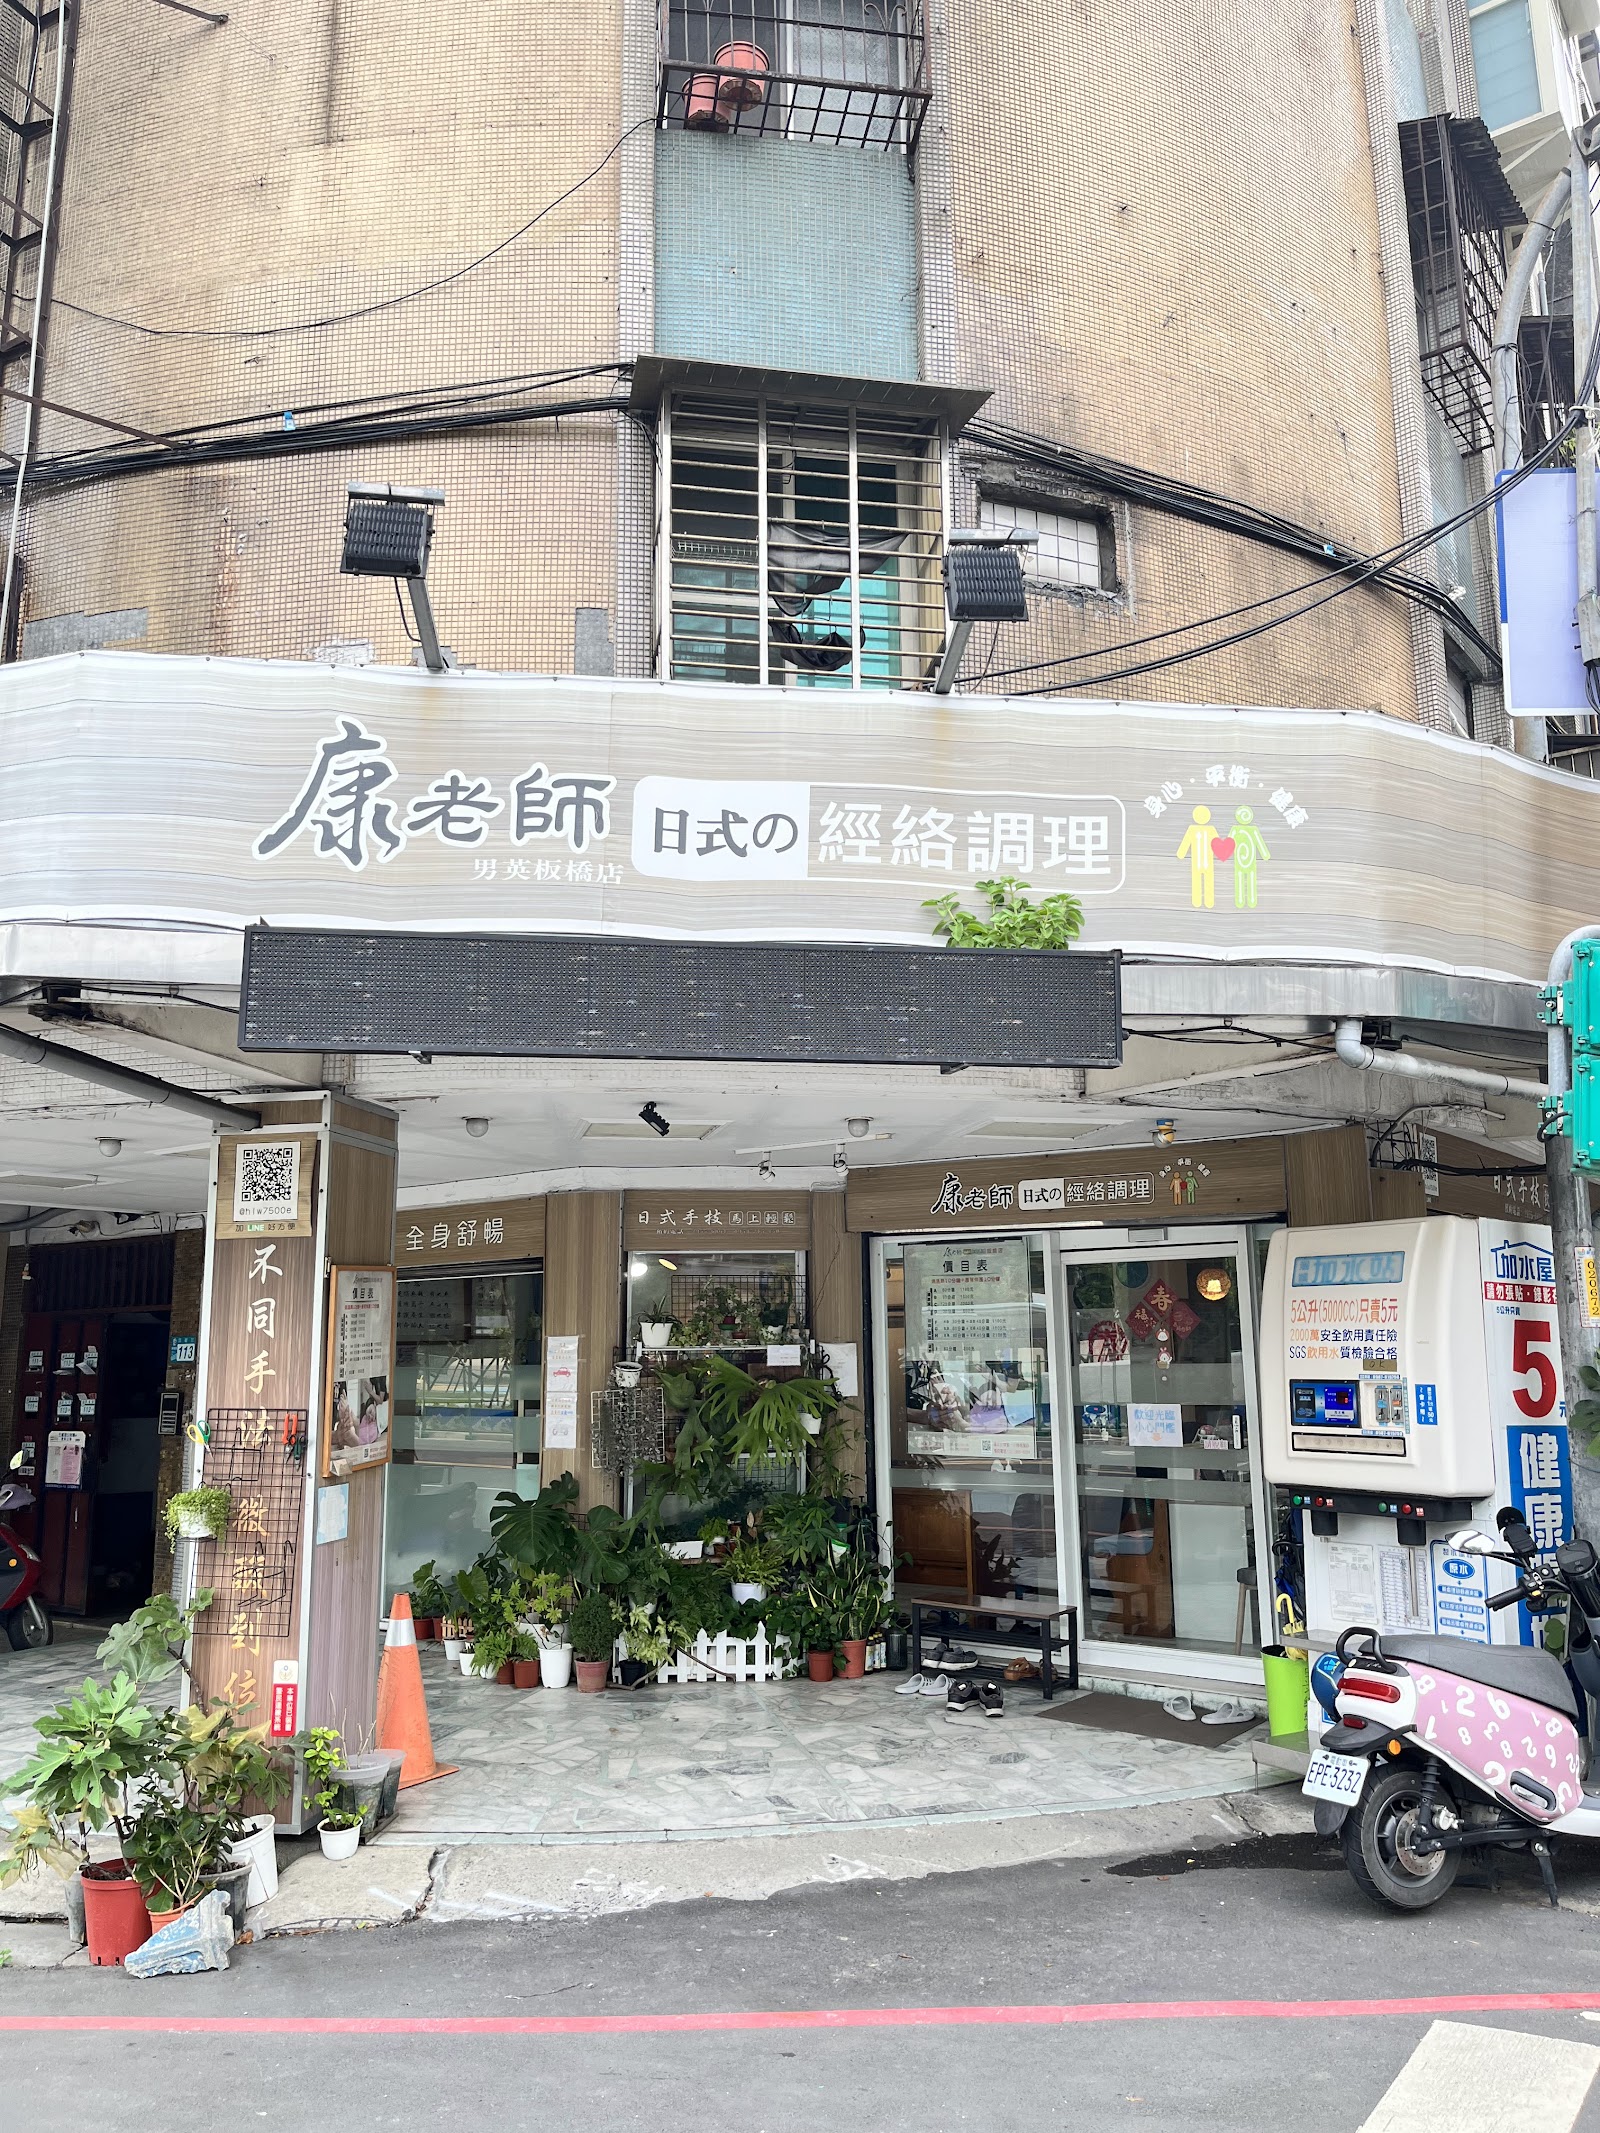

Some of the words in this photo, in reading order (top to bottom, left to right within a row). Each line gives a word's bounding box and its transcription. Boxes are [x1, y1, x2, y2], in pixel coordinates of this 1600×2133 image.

[254, 717, 615, 870] 康老師
[652, 808, 798, 858] 日式の
[818, 802, 1111, 875] 經絡調理
[471, 858, 624, 886] 男英板橋店
[930, 1172, 1014, 1215] 康老師
[1023, 1188, 1062, 1203] 日式の
[1066, 1178, 1150, 1203] 經絡調理
[638, 1209, 723, 1226] 日式手技
[406, 1218, 504, 1250] 全身舒暢
[942, 1259, 988, 1273] 價目表
[1151, 1285, 1173, 1312] 春
[1291, 1298, 1398, 1324] 5公升(5000CC)只賣5元
[1290, 1329, 1398, 1342] 2000萬安全飲用責任險
[178, 1345, 194, 1360] 113
[1289, 1345, 1398, 1360] SGS飲用水質檢驗合格
[1512, 1319, 1557, 1418] 5
[1449, 1562, 1469, 1575] 原水
[1307, 1761, 1362, 1794] EPE-3232
